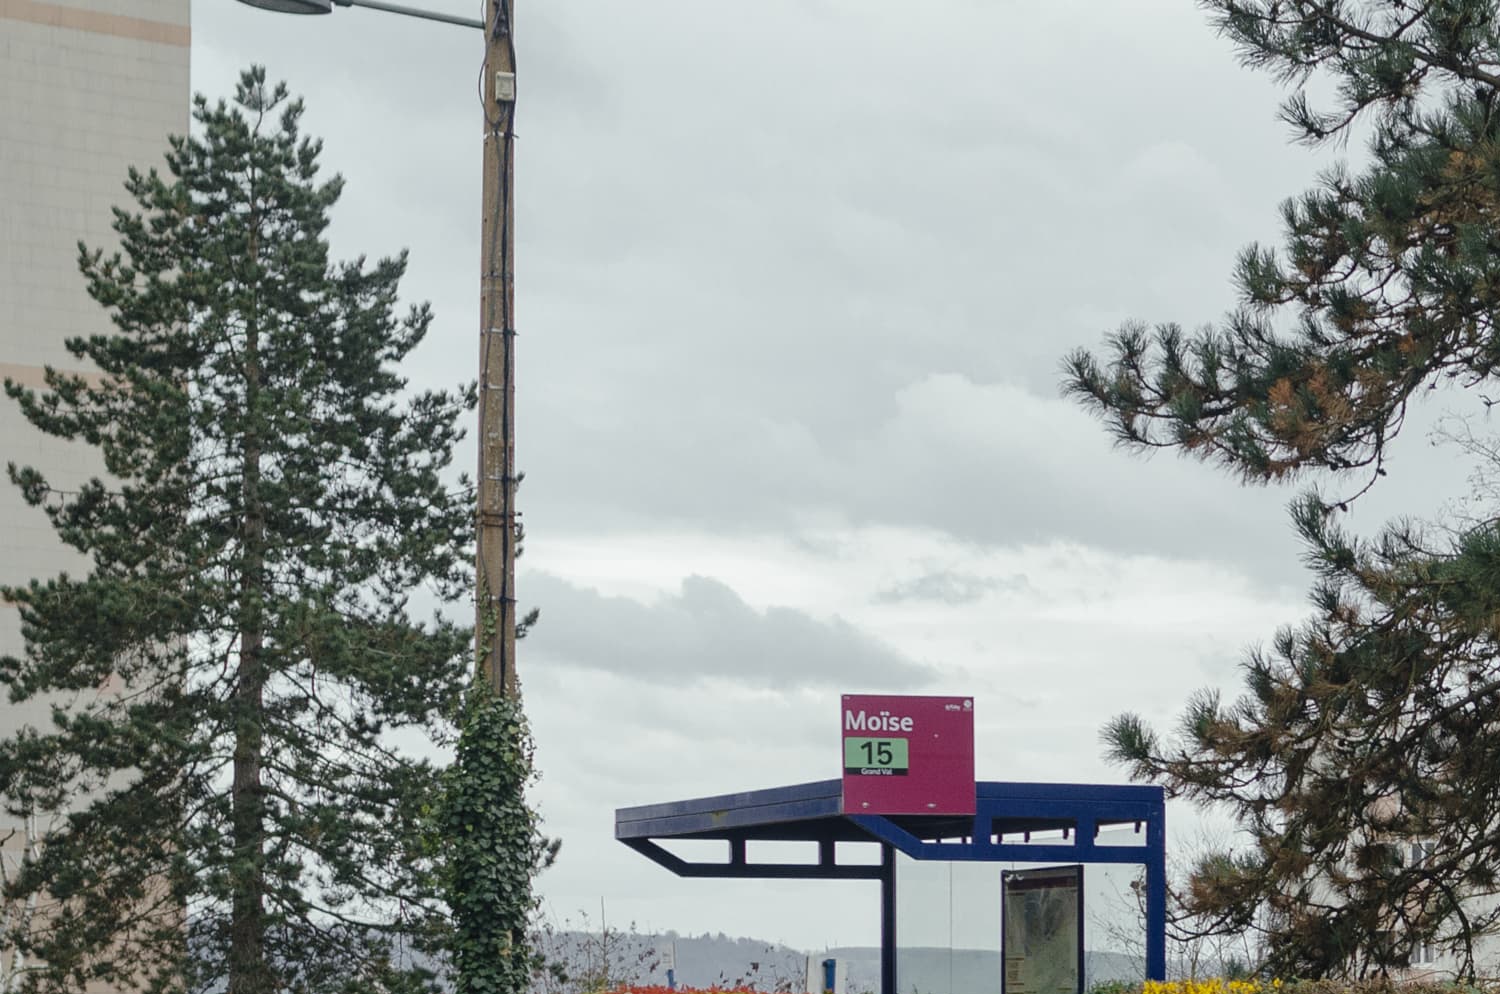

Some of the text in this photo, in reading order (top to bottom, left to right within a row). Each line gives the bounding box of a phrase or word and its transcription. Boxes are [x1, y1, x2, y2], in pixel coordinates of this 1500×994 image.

[845, 710, 914, 732] Moïse
[860, 741, 893, 765] 15
[861, 767, 893, 775] Grand Val
